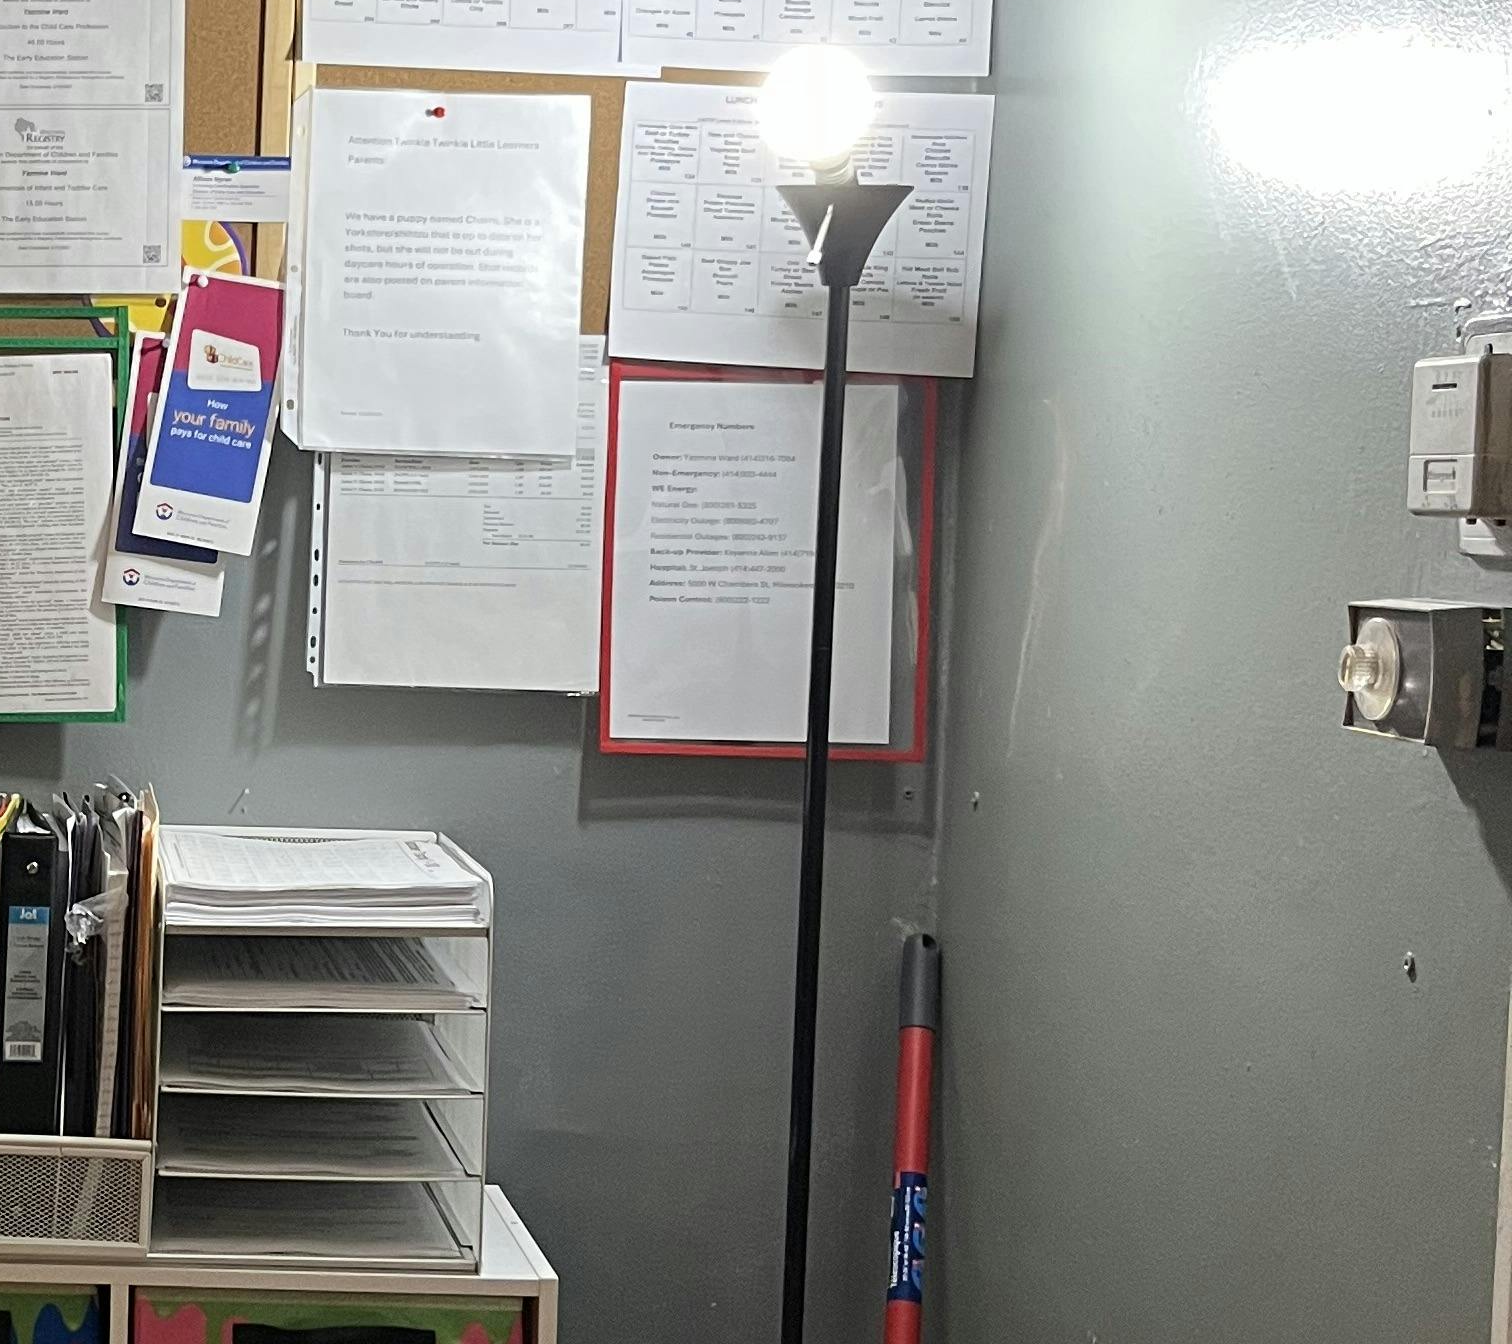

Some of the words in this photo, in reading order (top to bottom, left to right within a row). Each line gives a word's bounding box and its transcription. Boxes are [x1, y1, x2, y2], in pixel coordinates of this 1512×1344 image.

[344, 328, 371, 336] Thank
[373, 329, 393, 337] You
[394, 330, 408, 338] for
[207, 399, 229, 410] How
[172, 410, 206, 426] your
[210, 413, 256, 438] family
[669, 422, 715, 431] Emergency
[170, 427, 192, 438] pays
[194, 430, 208, 440] for
[209, 433, 230, 445] child
[232, 439, 252, 449] care
